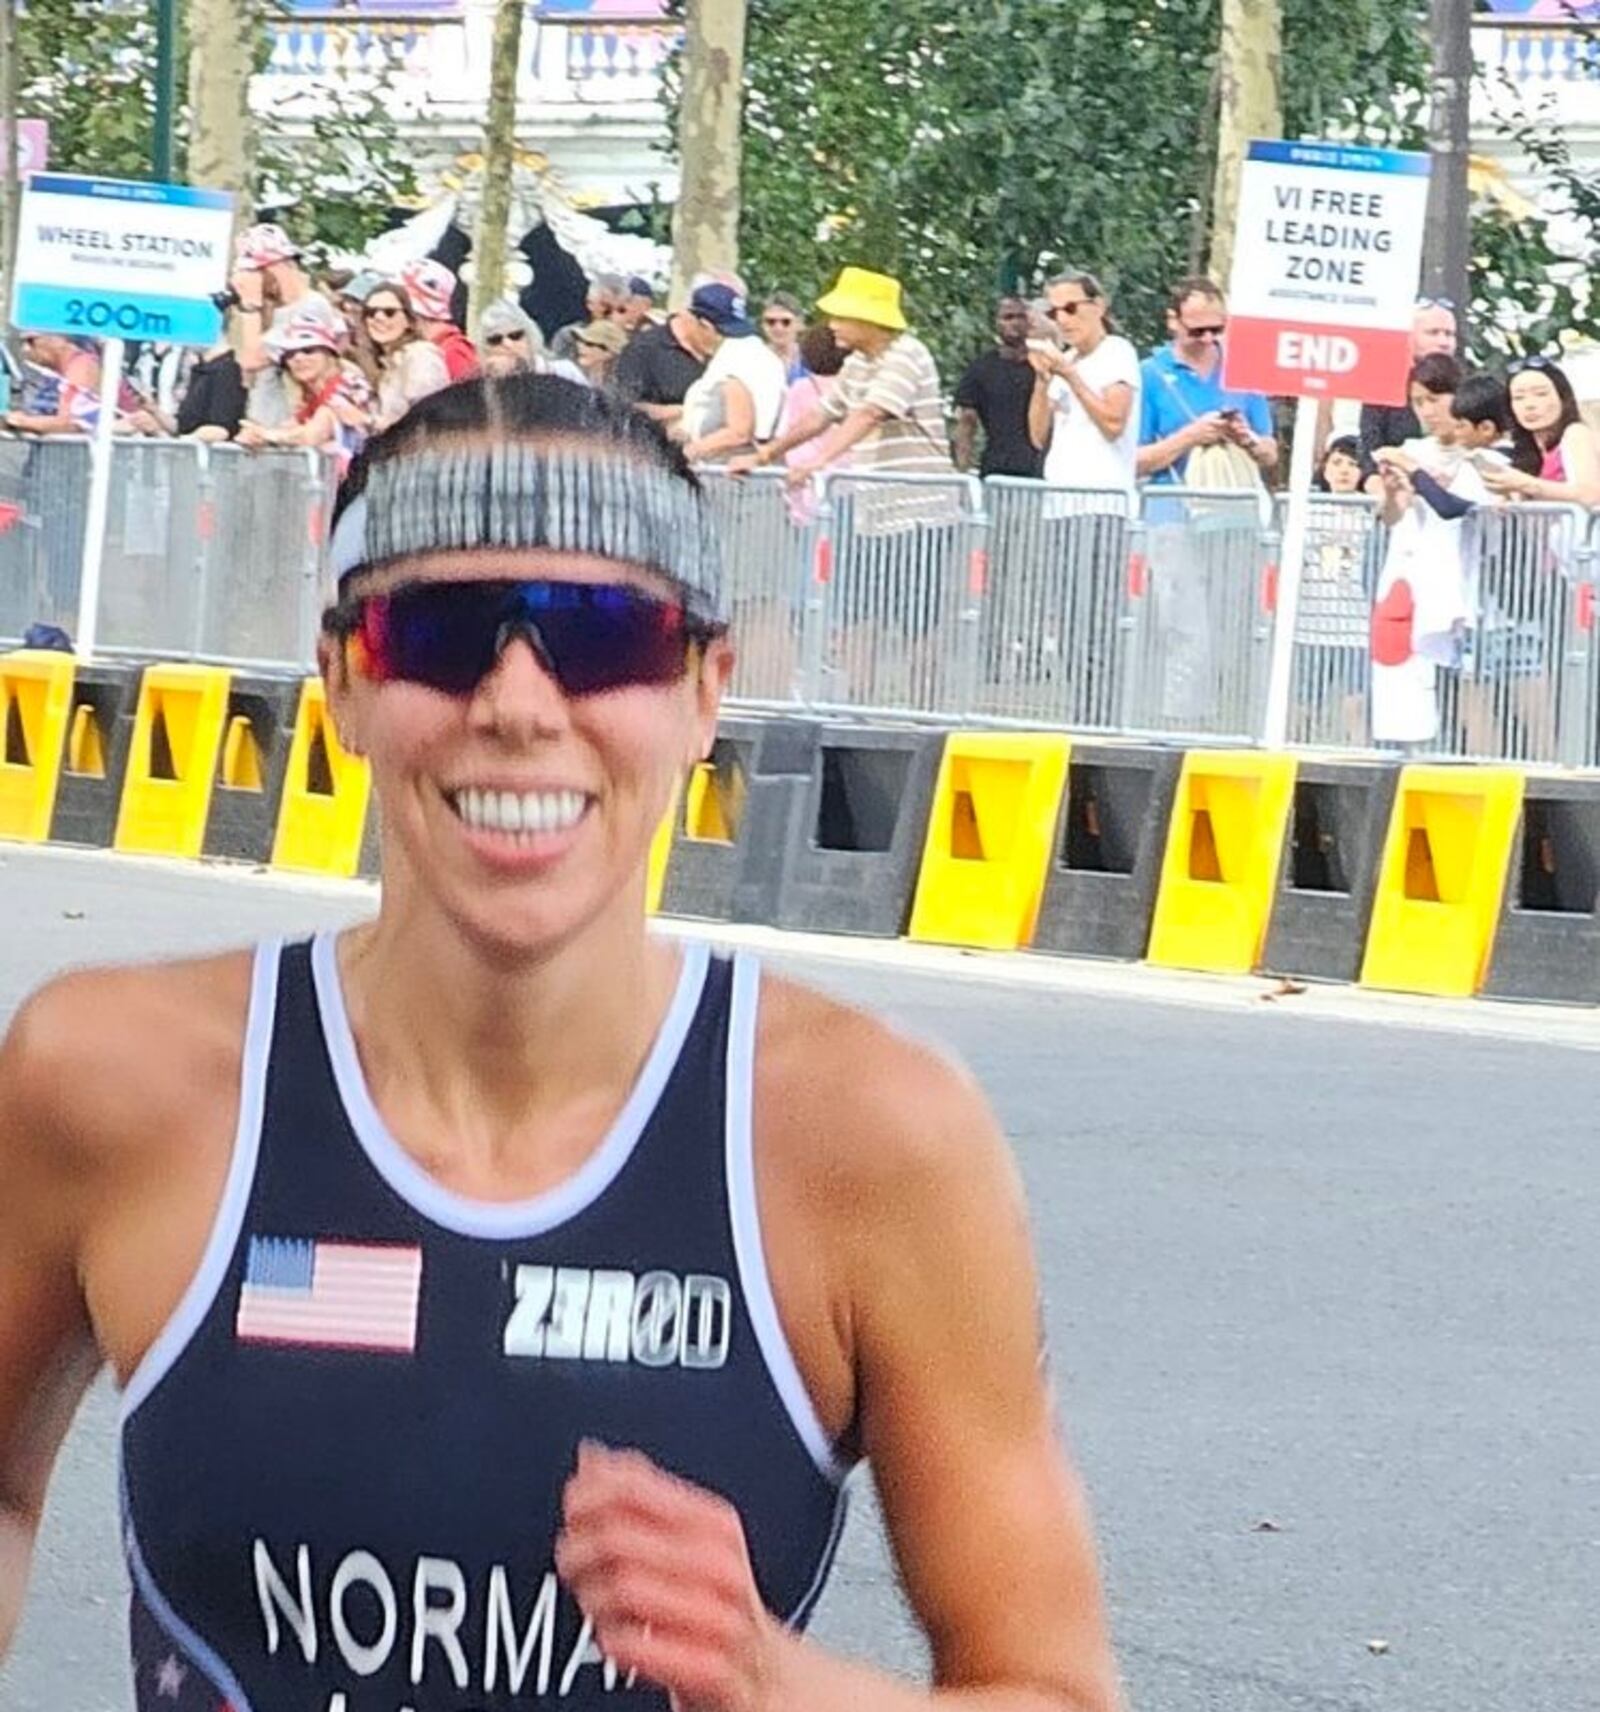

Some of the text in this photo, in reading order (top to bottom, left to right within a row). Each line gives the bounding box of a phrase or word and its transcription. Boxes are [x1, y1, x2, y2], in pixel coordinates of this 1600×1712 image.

[1274, 185, 1383, 218] VI FREE
[37, 224, 213, 258] WHEEL STATION
[1266, 219, 1392, 253] LEADING
[1285, 255, 1365, 285] ZONE
[65, 299, 172, 334] 200m
[1276, 330, 1359, 373] END
[253, 1537, 638, 1696] NORMA
